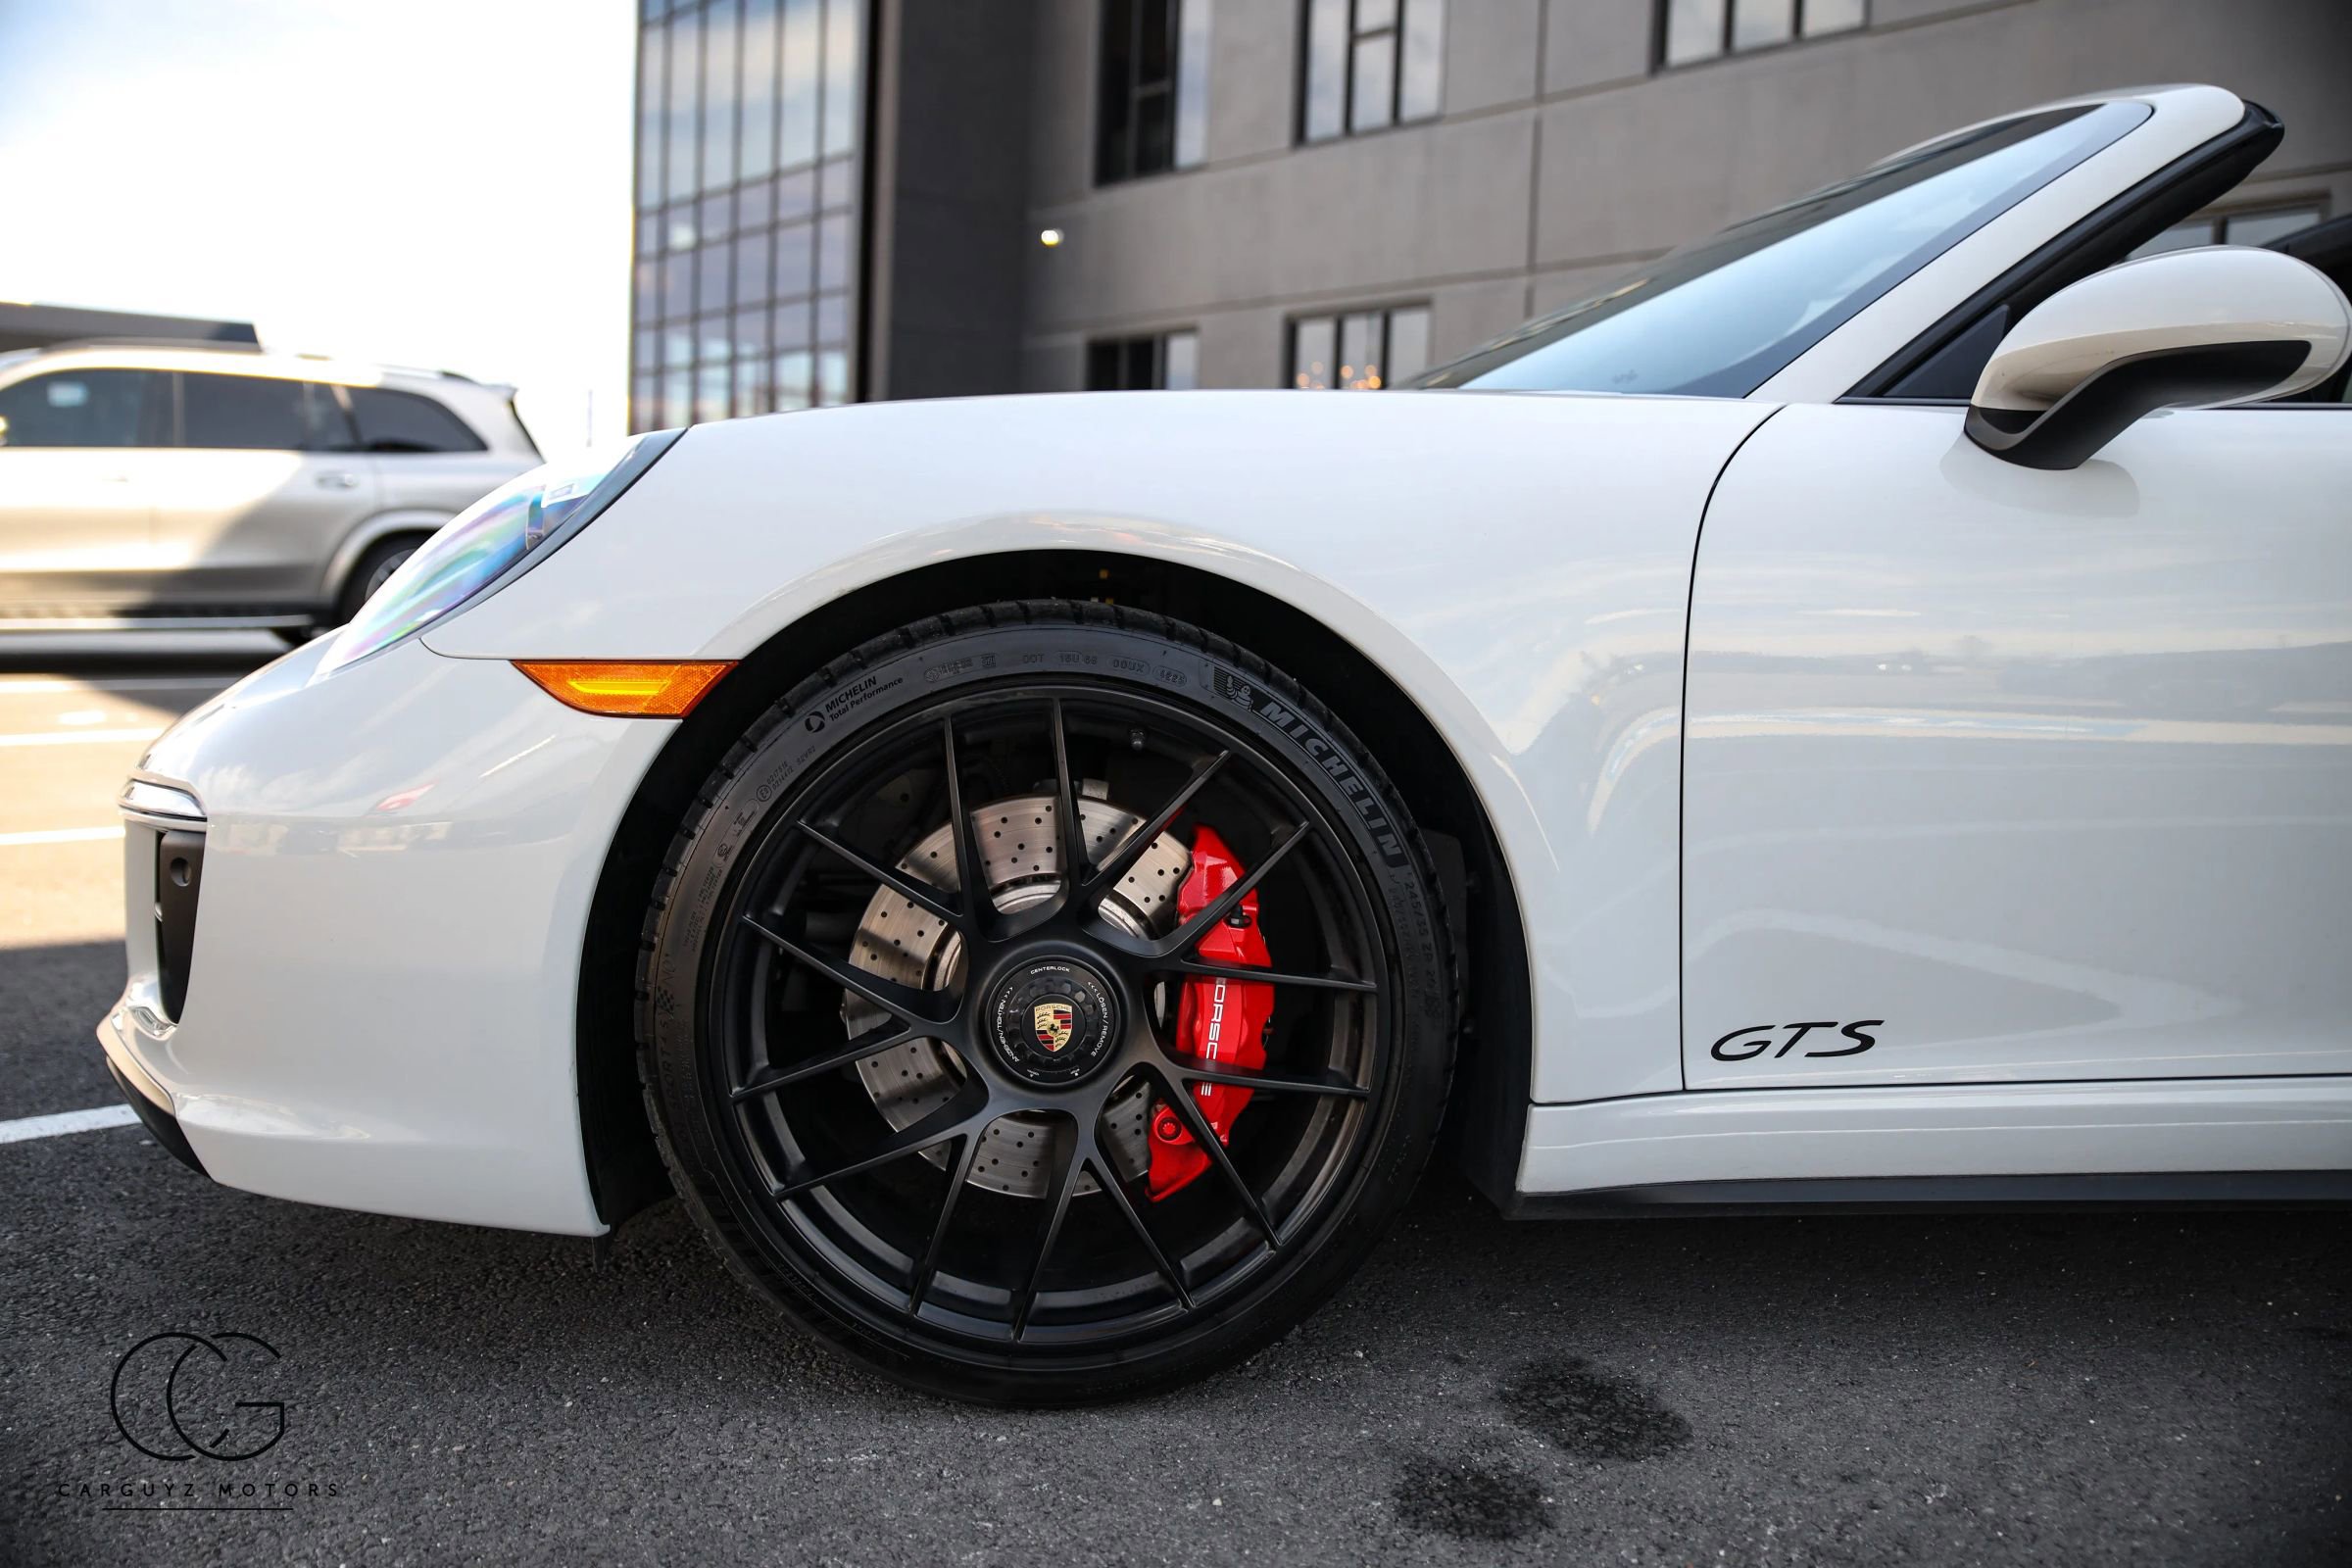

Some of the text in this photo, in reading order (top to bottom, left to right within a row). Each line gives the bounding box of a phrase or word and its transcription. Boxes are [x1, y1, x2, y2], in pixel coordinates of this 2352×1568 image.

[825, 676, 877, 712] MICHELIN
[829, 677, 904, 721] Total Performance
[1260, 702, 1402, 857] MICHELIN
[1030, 965, 1070, 975] CENTERLOCK
[1091, 1026, 1108, 1057] REMOVE
[1200, 978, 1227, 1097] ORSCE
[1710, 1019, 1885, 1061] GTS
